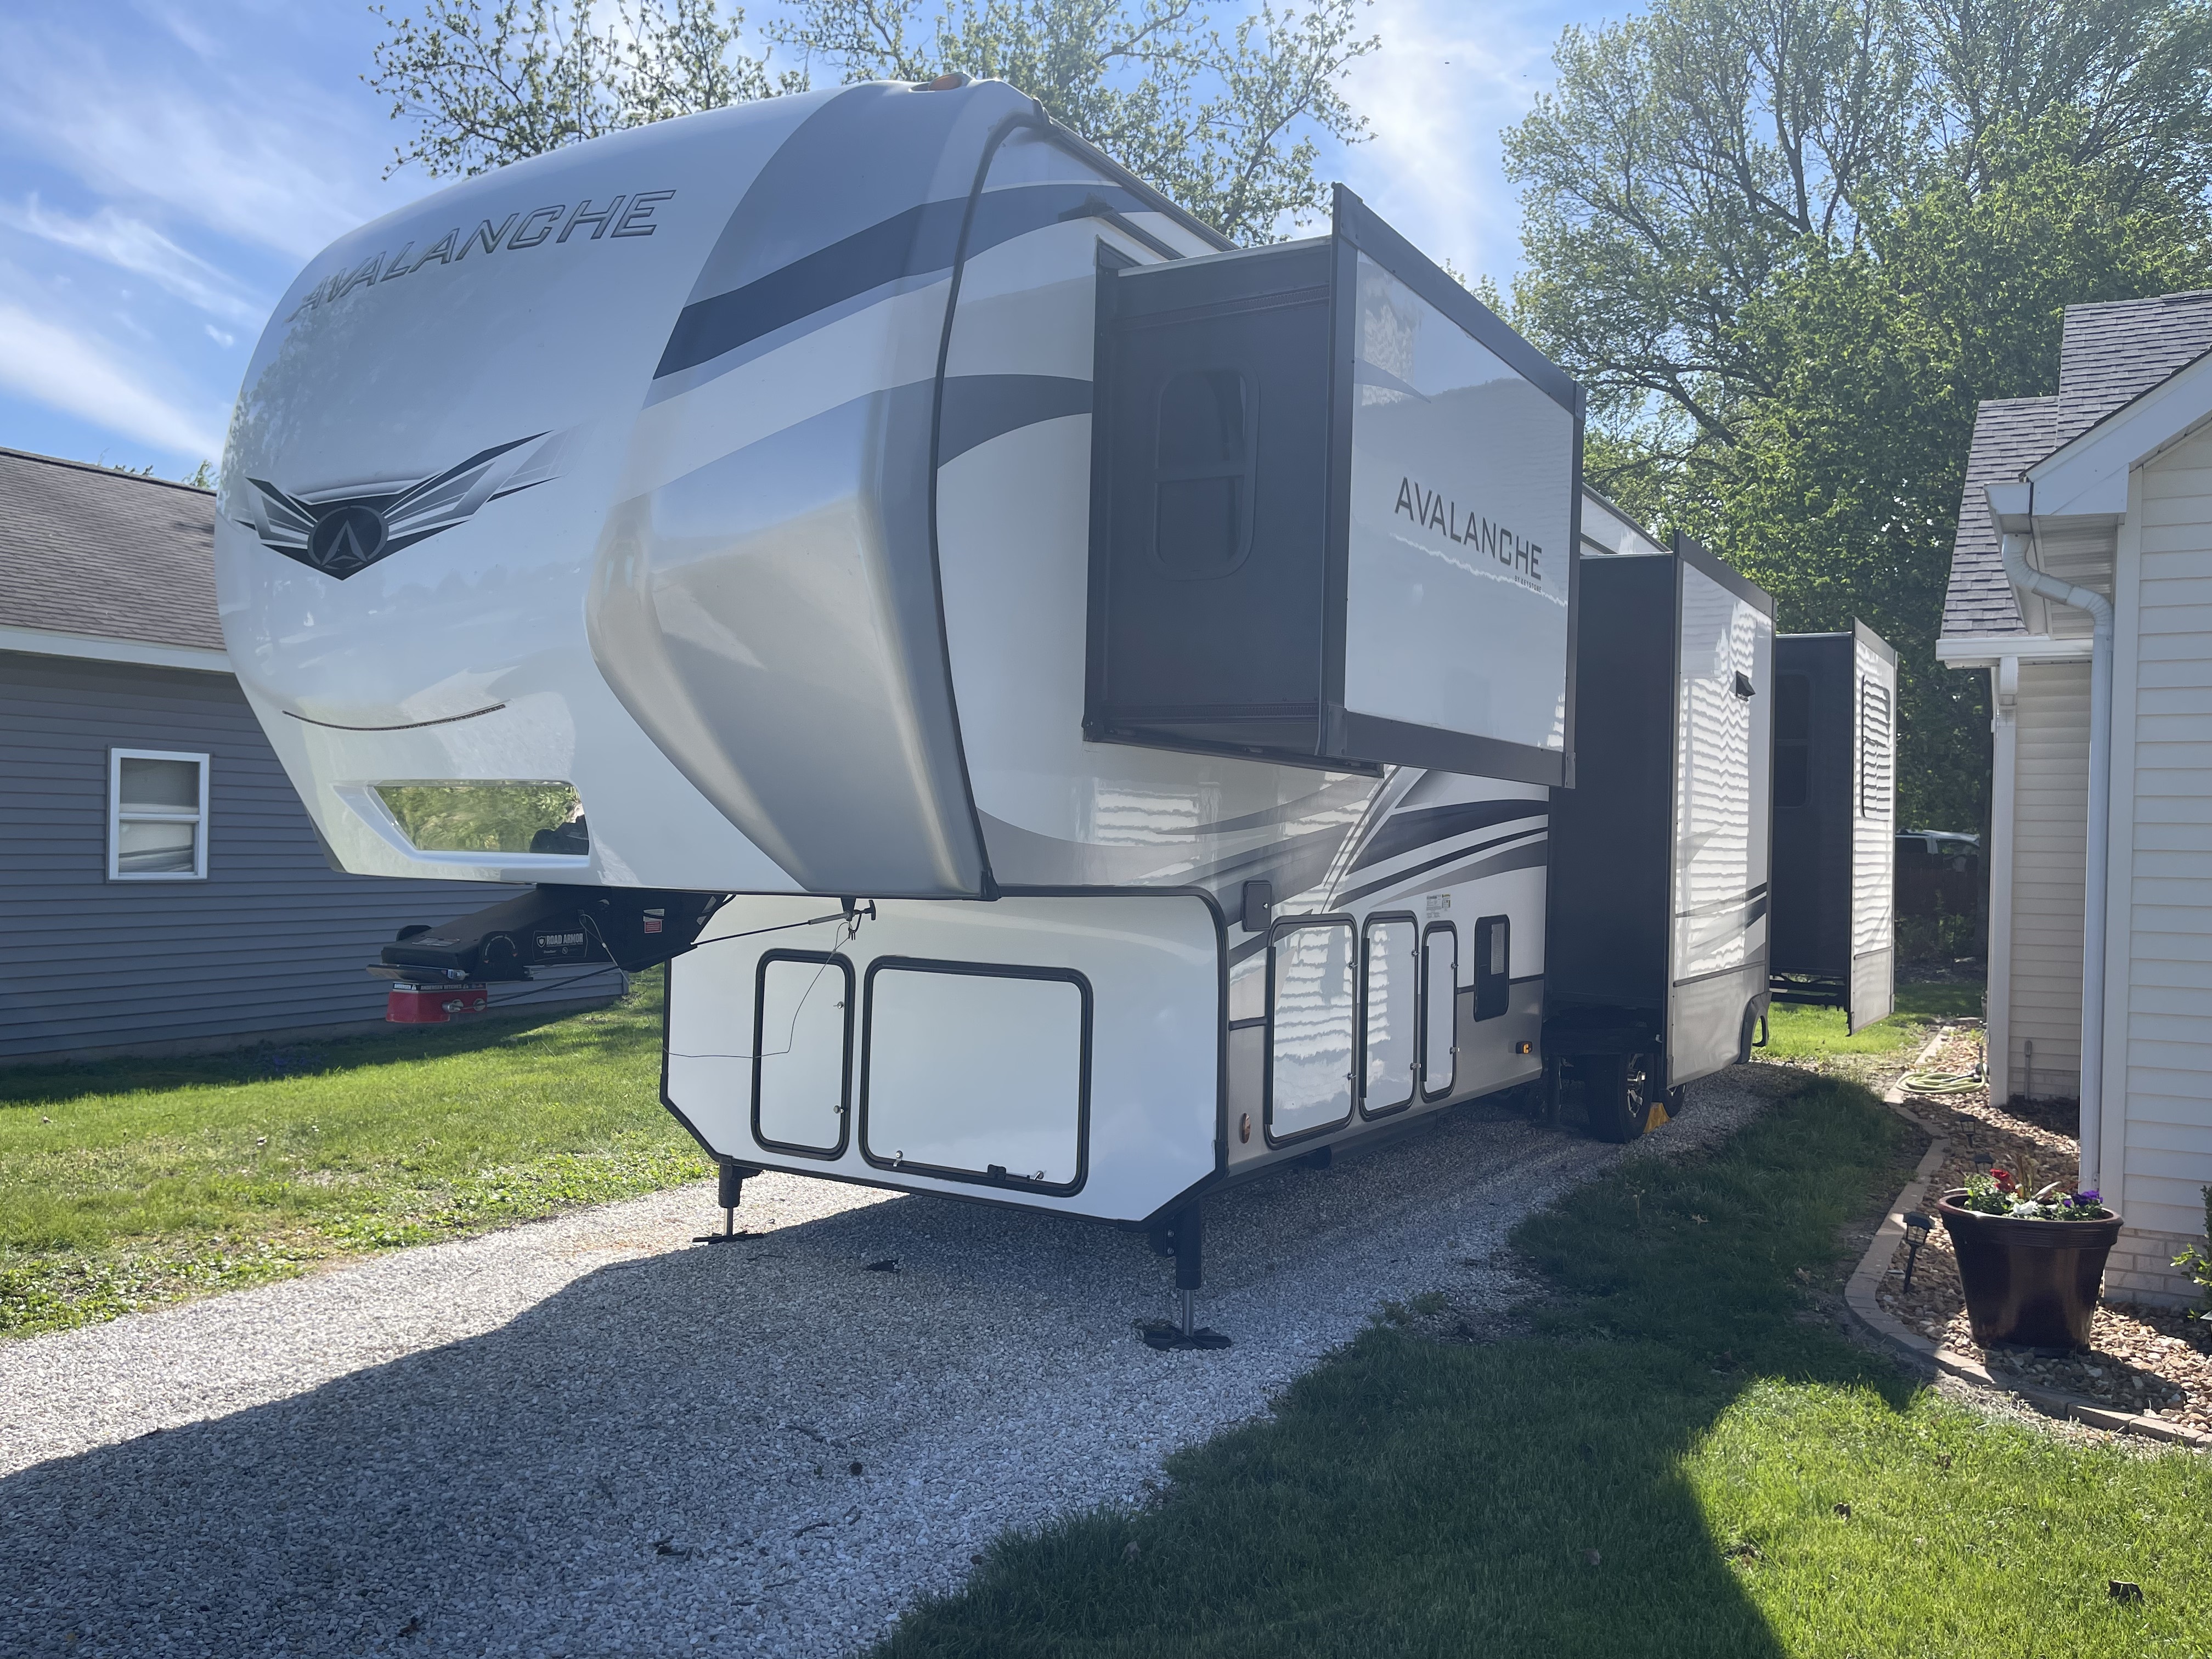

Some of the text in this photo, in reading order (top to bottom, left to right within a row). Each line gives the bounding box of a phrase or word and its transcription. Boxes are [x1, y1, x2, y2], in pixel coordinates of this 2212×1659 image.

[285, 189, 676, 323] AVALANCHE
[1394, 476, 1542, 580] AVALANCHE
[1521, 578, 1542, 593] KEYSTONE
[546, 933, 583, 945] ROAD ARMOR
